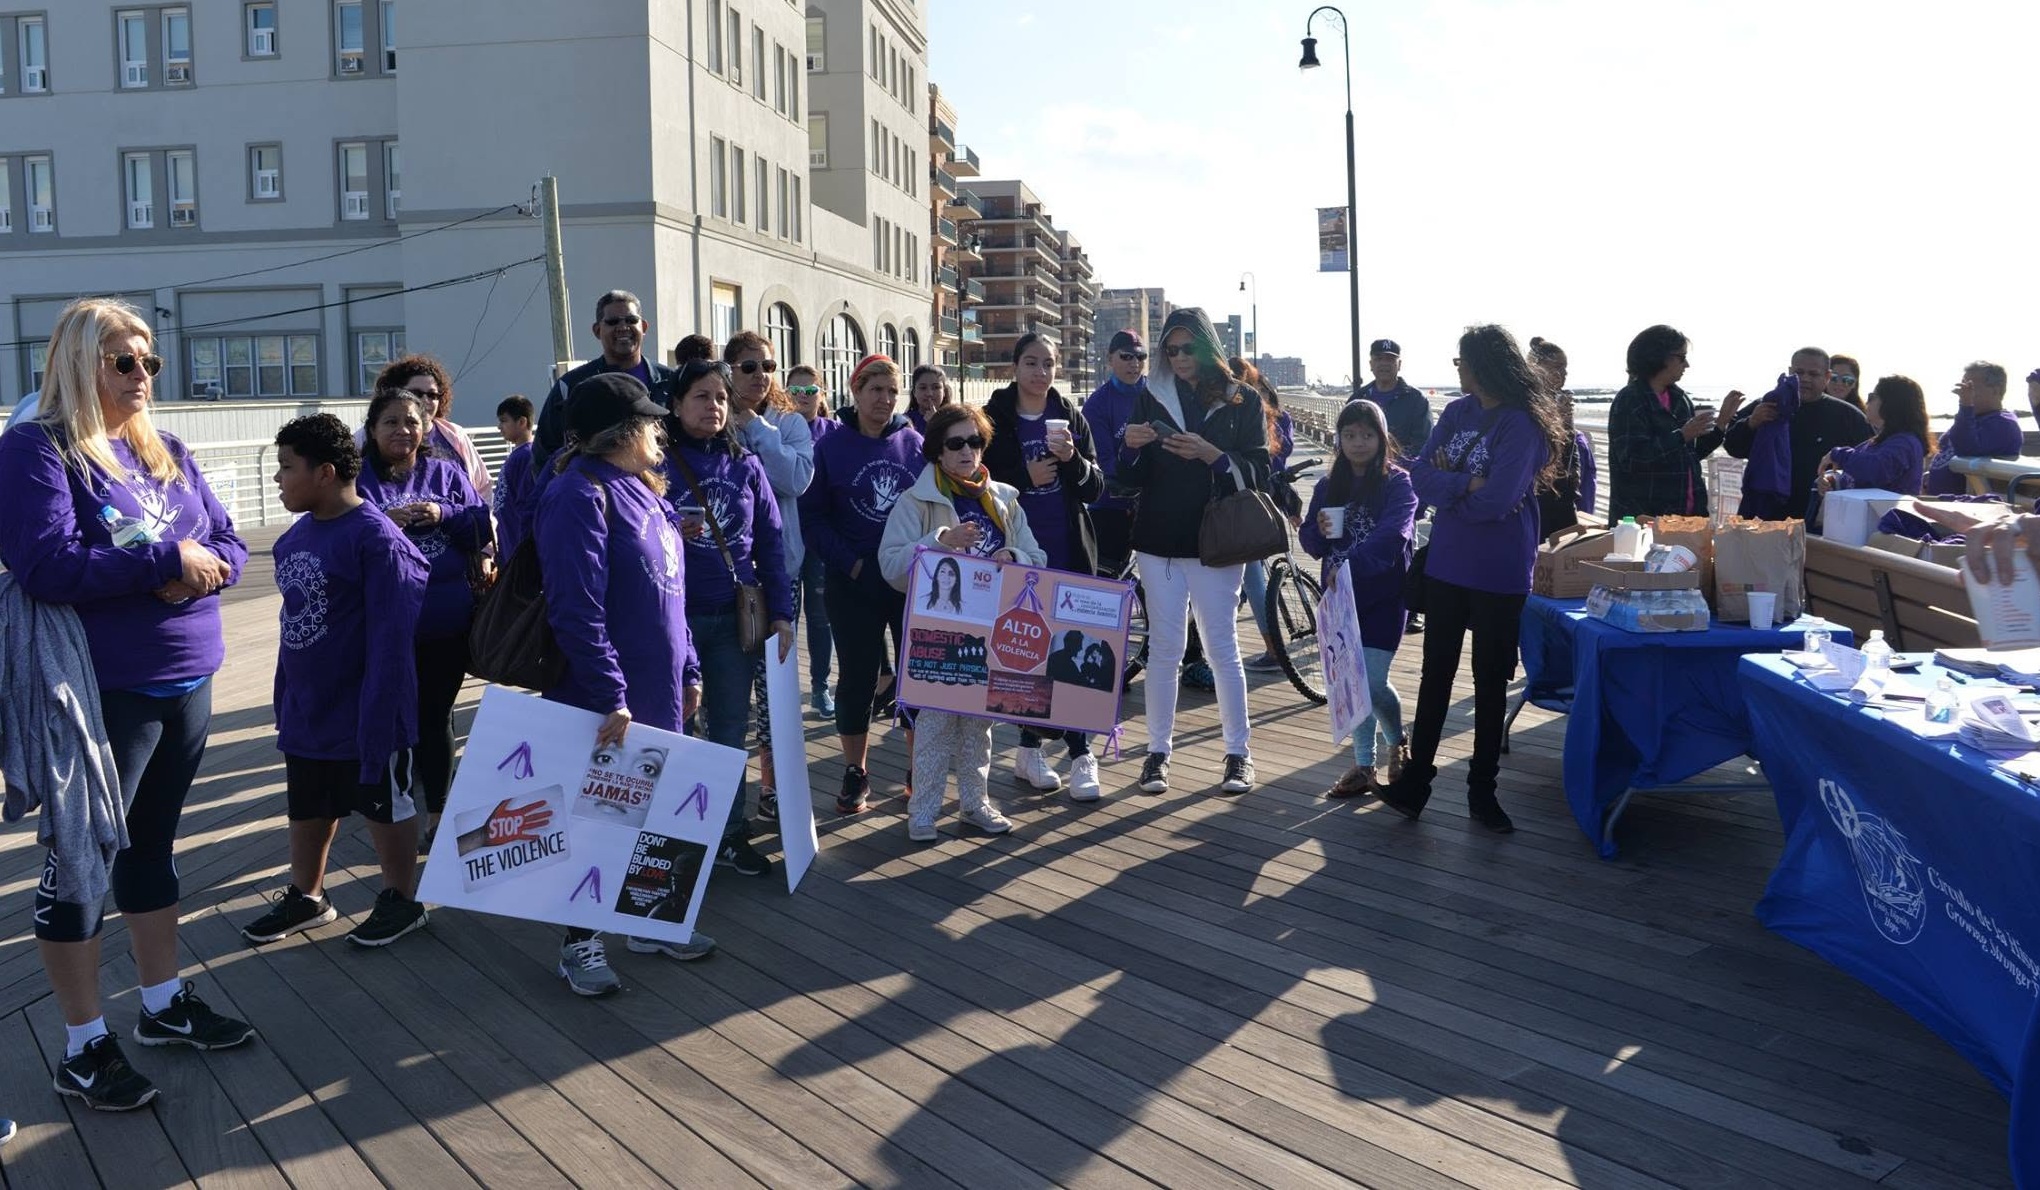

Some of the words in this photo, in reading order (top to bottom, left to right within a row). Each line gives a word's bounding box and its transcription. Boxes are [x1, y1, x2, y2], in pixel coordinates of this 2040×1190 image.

[973, 571, 992, 583] NO
[1002, 618, 1042, 639] ALTO
[910, 629, 966, 646] DOMESTIC
[1019, 639, 1029, 648] LA
[910, 646, 947, 660] ABUSE
[996, 643, 1040, 661] VIOLENCIA
[923, 661, 937, 669] NOT
[941, 662, 957, 670] JUST
[626, 776, 654, 788] OCURRA
[488, 815, 524, 839] STOP
[639, 833, 667, 848] DONT
[465, 853, 496, 882] THE
[497, 831, 566, 872] VIOLENCE
[635, 843, 649, 855] BE
[631, 853, 671, 870] BLINDED
[628, 864, 642, 876] BY
[1975, 905, 1993, 932] de
[1945, 902, 1988, 952] Growing
[1988, 938, 2031, 989] Stronger
